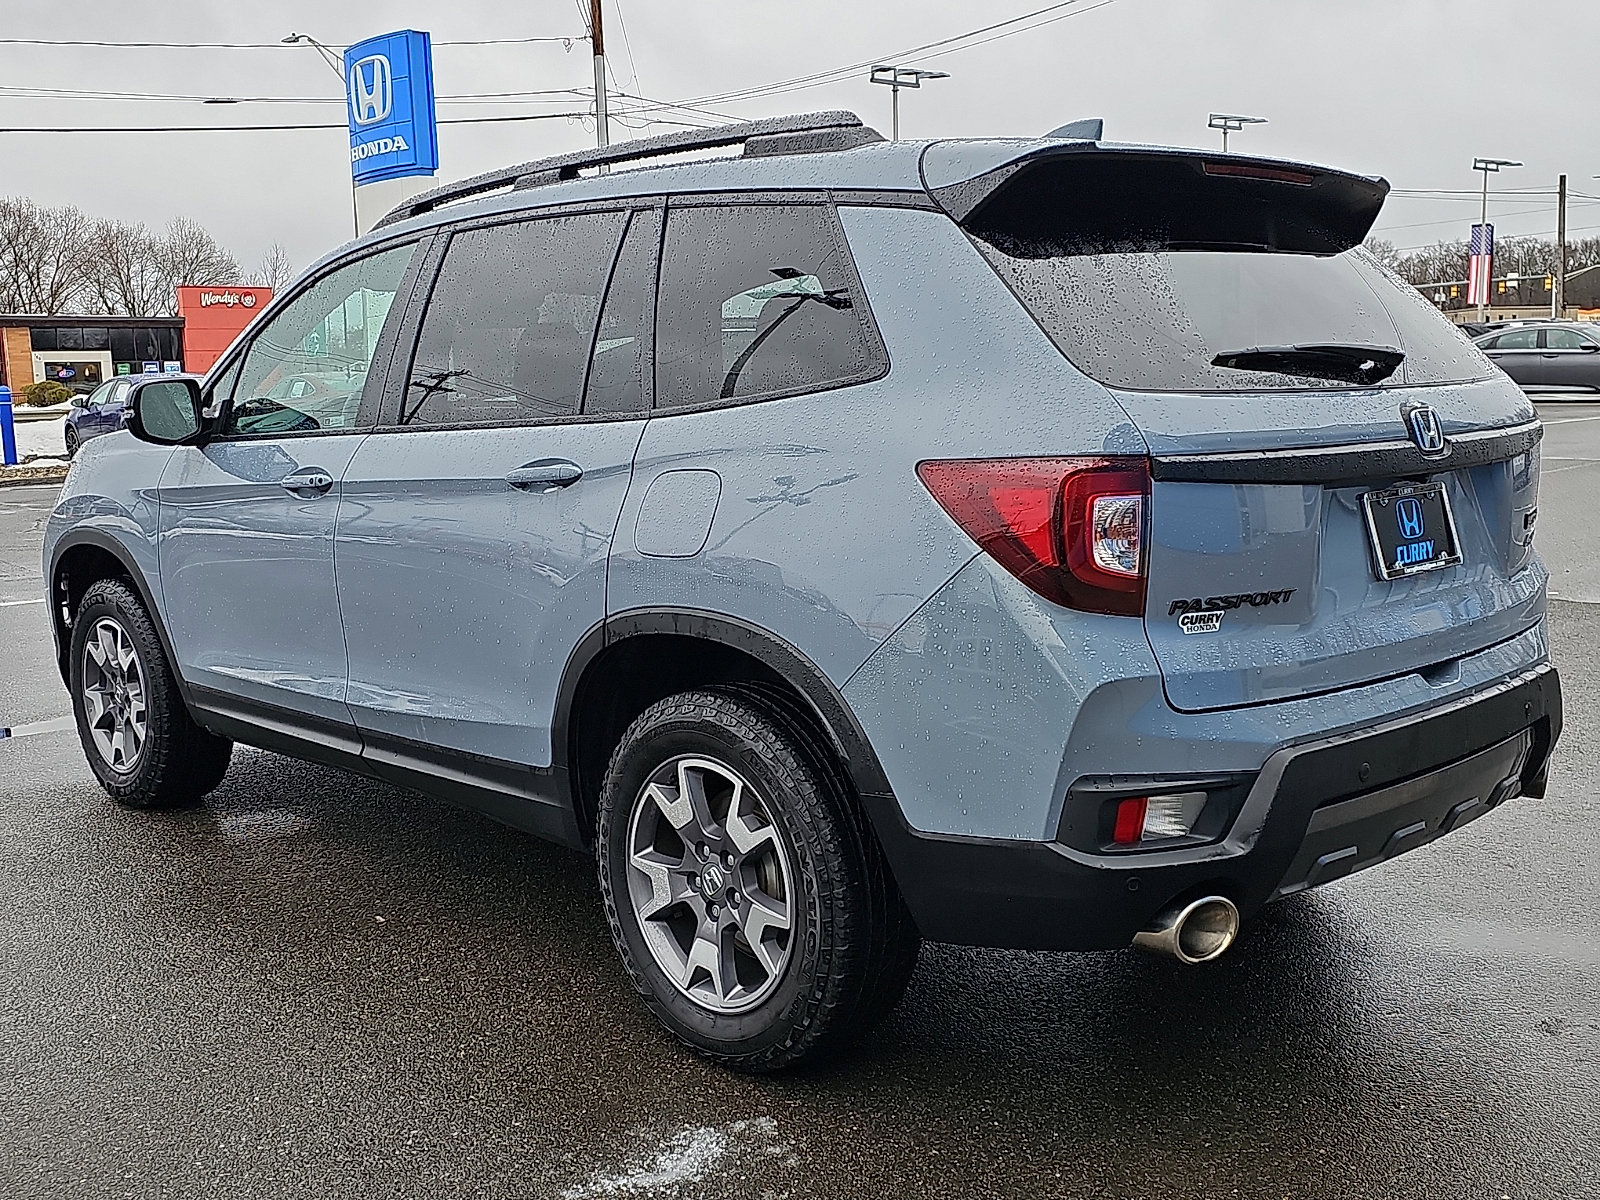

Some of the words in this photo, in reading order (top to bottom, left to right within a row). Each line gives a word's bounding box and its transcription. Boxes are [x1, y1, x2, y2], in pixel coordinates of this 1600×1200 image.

[351, 135, 409, 162] HONDA
[200, 290, 239, 307] Wendy's
[1396, 540, 1435, 565] CURRY
[1167, 588, 1297, 615] PASSPORT
[1180, 612, 1223, 627] CURRY
[1186, 624, 1218, 633] HONDA
